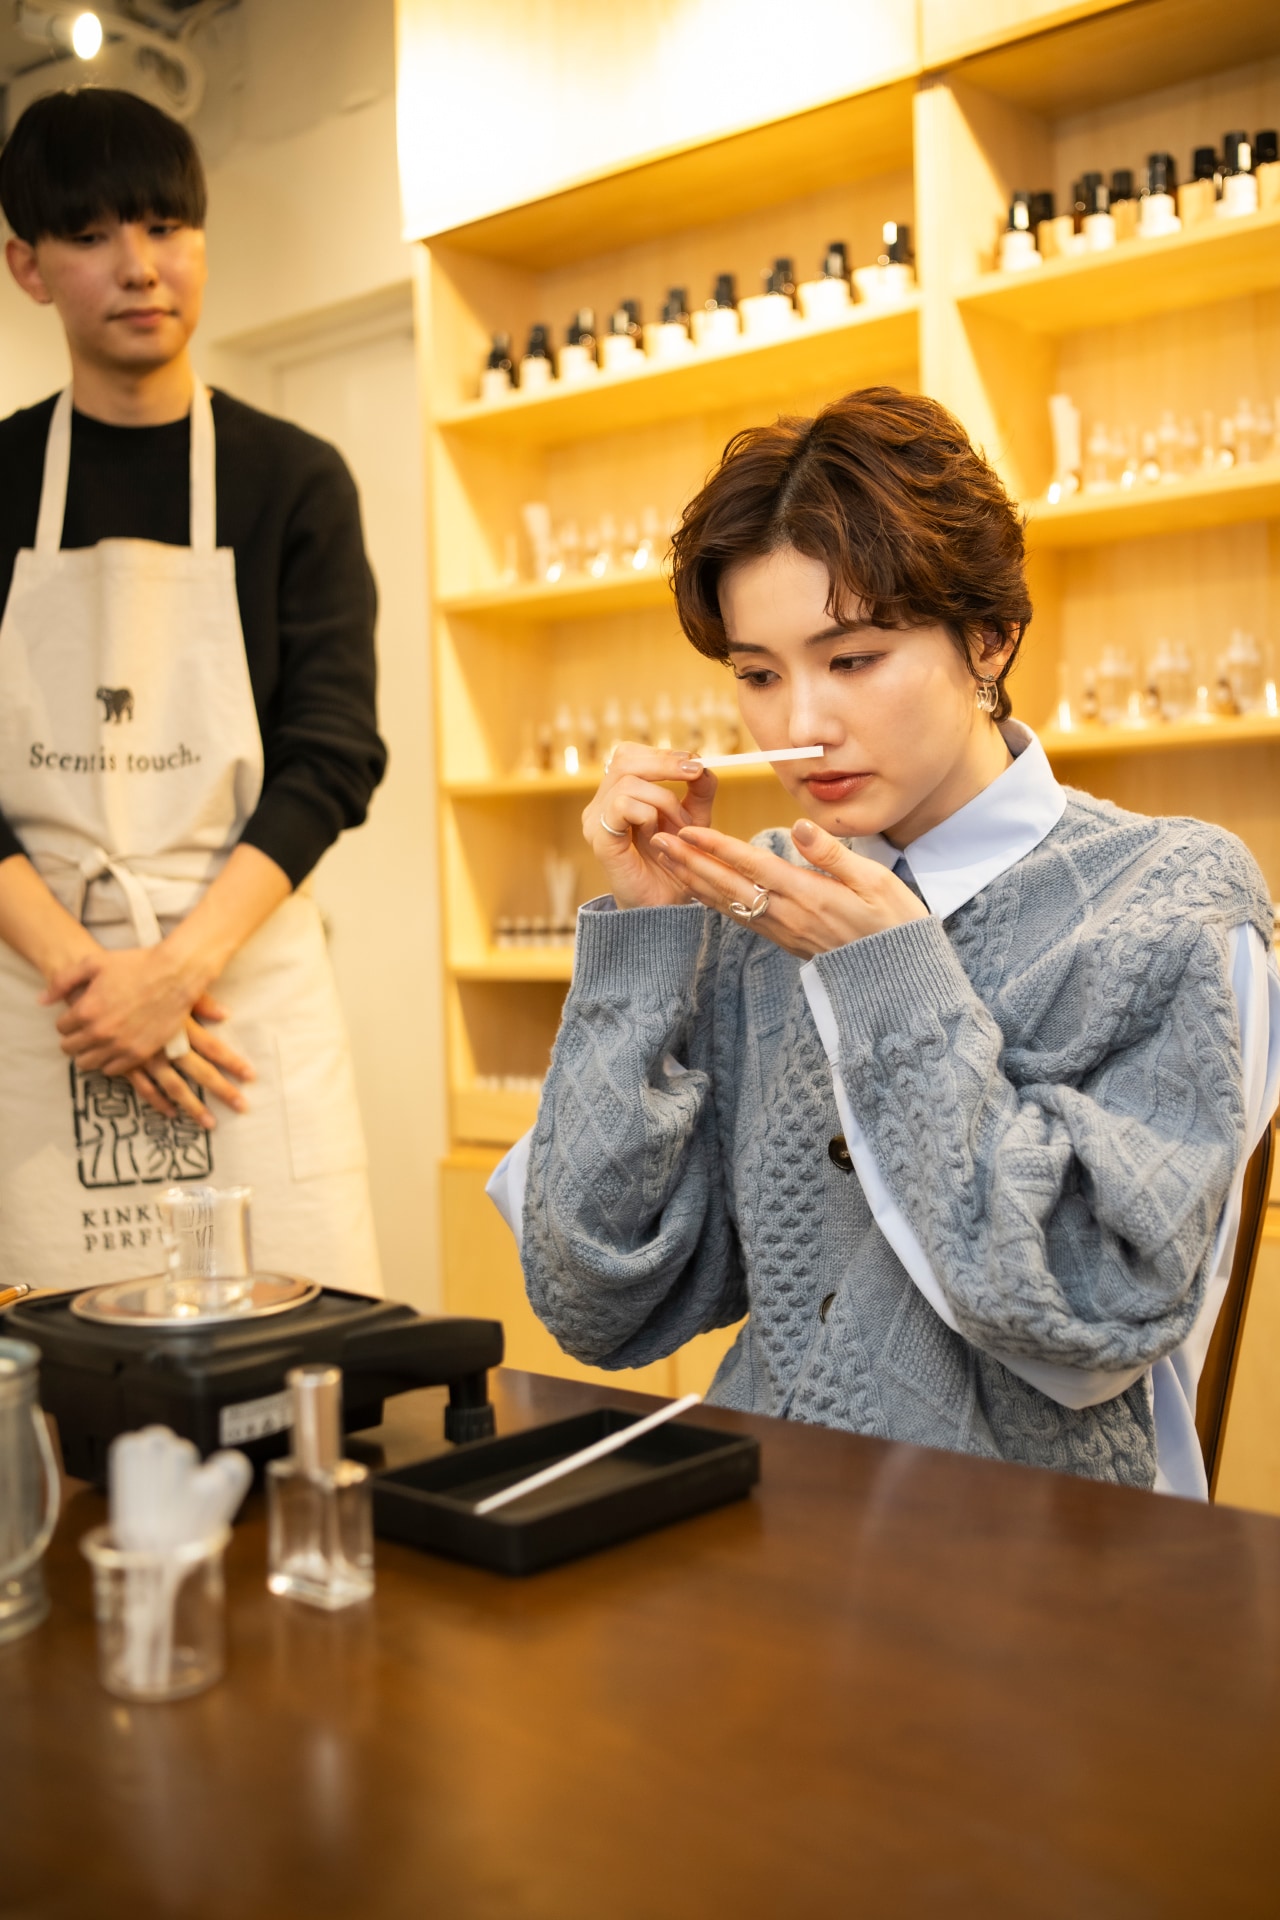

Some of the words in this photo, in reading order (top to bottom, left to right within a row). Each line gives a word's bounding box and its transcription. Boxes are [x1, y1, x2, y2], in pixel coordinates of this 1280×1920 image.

[29, 741, 97, 773] Scent
[100, 745, 117, 771] is
[126, 742, 201, 773] touch.
